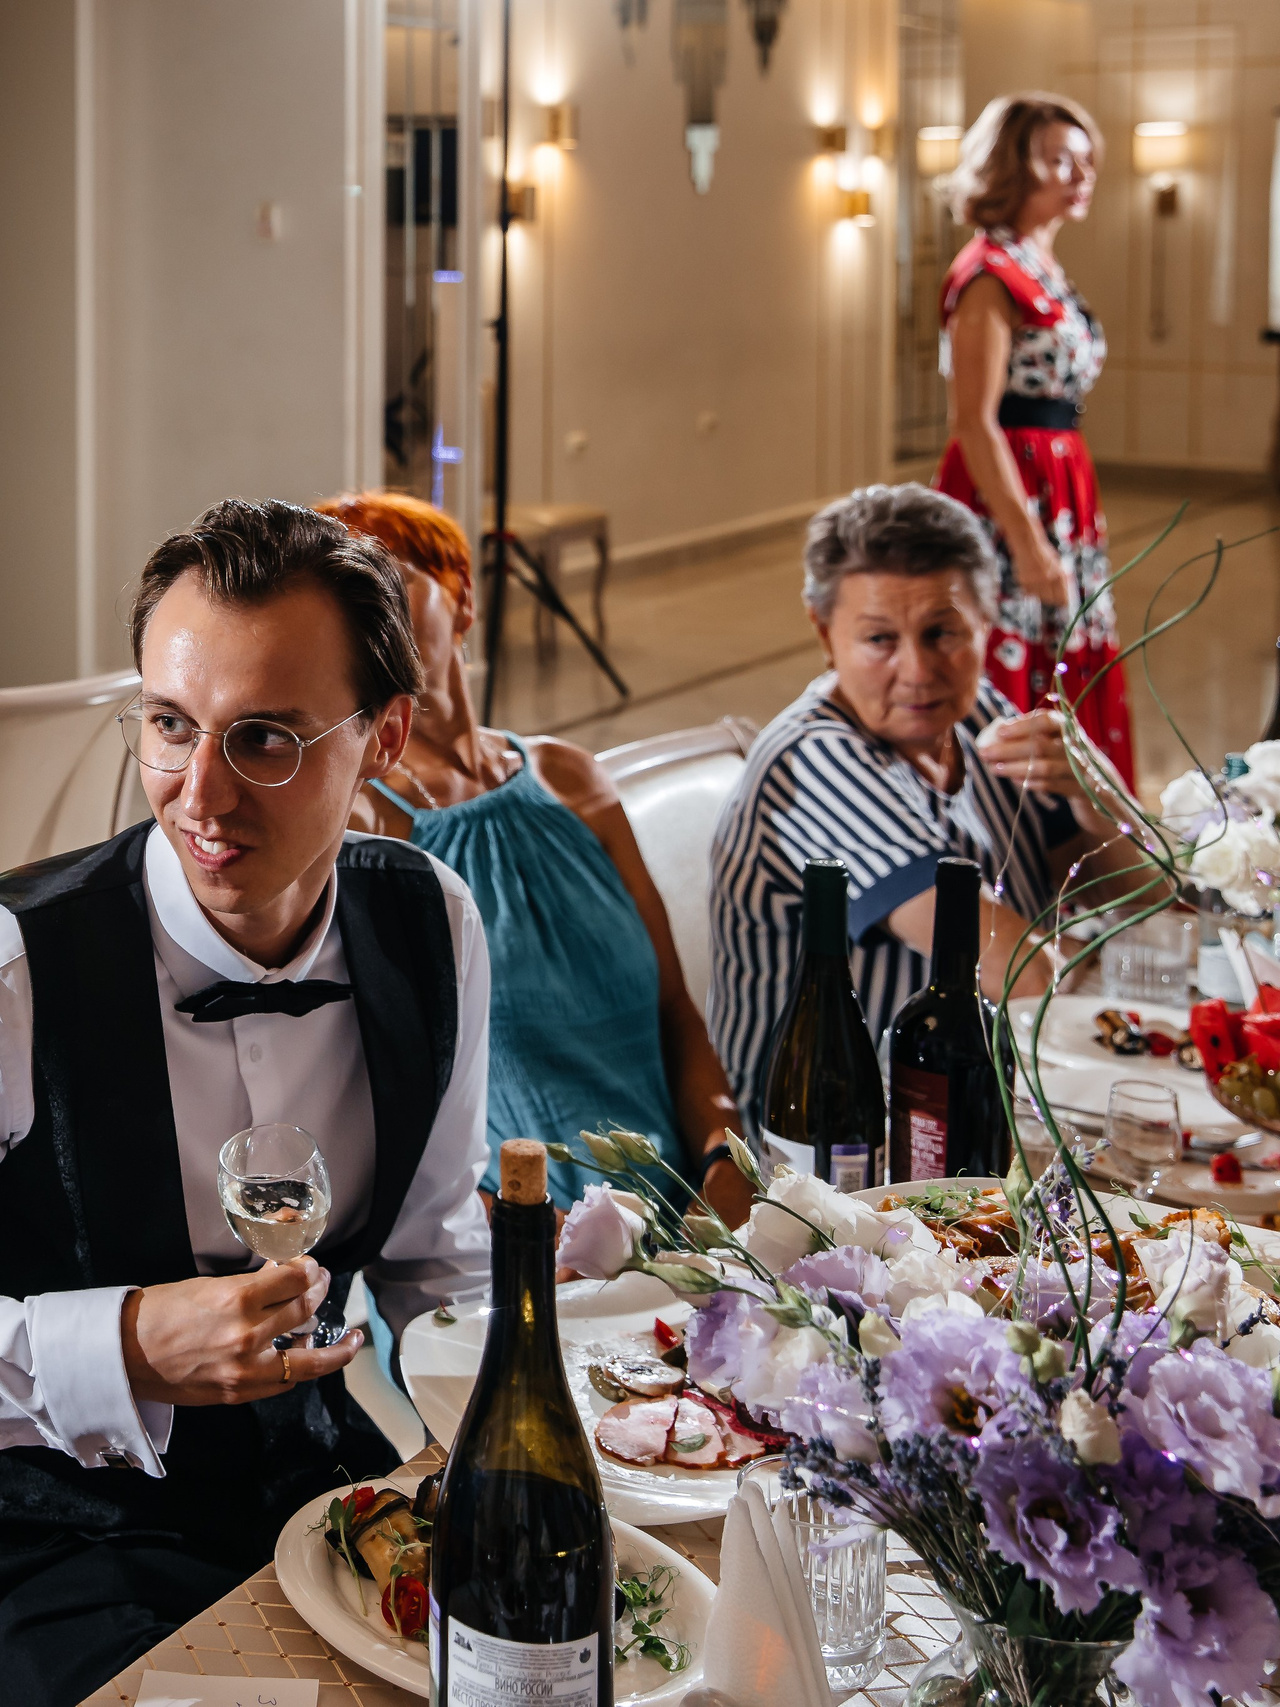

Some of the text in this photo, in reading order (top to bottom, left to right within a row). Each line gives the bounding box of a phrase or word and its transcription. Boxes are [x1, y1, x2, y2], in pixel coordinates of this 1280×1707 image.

[452, 1685, 473, 1707] МЕСТО
[495, 1677, 518, 1694] ВИНО
[520, 1681, 553, 1697] РОССИИ
